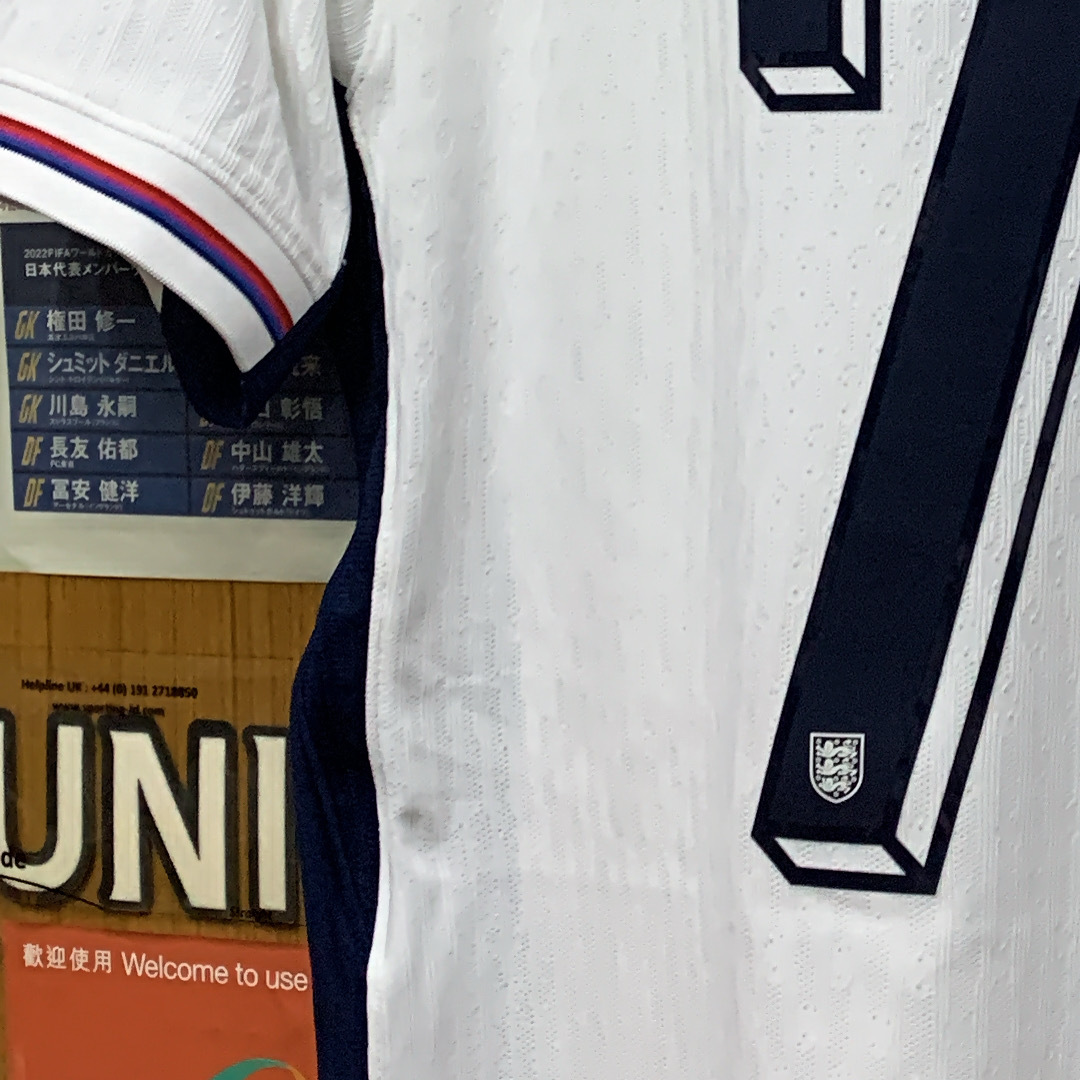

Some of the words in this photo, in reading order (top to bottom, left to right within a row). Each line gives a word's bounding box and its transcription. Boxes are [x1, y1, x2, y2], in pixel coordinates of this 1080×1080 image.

[15, 309, 40, 340] GK
[17, 352, 42, 382] GK
[19, 393, 43, 424] GK
[49, 394, 88, 417] 川島
[21, 436, 44, 466] DF
[50, 436, 90, 460] 長友
[201, 439, 225, 470] DF
[231, 439, 273, 463] 中山
[23, 477, 46, 508] DF
[201, 482, 225, 513] DF
[21, 679, 64, 693] Helpline
[66, 681, 83, 692] UK
[91, 682, 110, 694] +44
[131, 684, 149, 696] 191
[22, 943, 112, 974] 歡迎使用
[121, 951, 229, 985] Welcome
[235, 964, 259, 987] to
[265, 970, 308, 992] use
